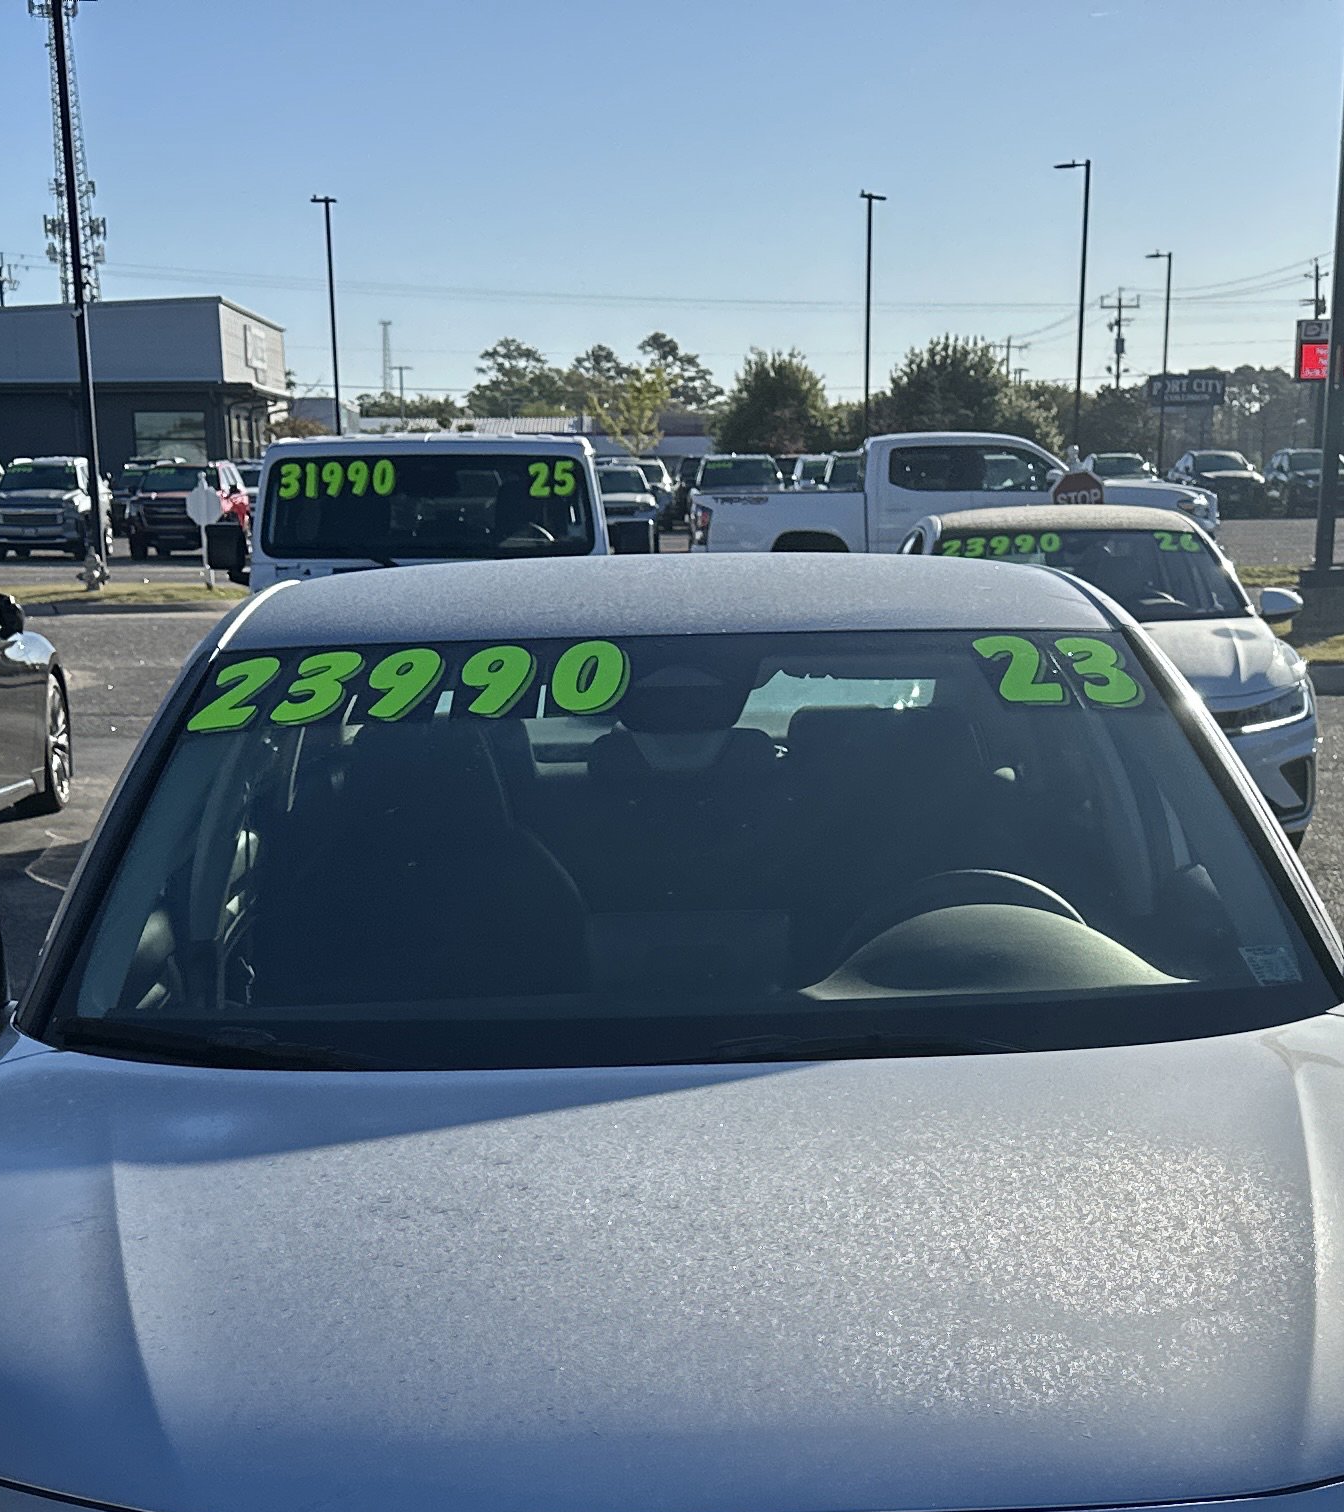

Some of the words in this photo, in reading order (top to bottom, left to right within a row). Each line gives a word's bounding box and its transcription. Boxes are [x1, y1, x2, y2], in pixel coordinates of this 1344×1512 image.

[278, 459, 396, 499] 31990
[528, 460, 576, 497] 25
[1056, 489, 1101, 504] STOP
[942, 533, 1061, 557] 23990
[1154, 533, 1200, 552] 26
[186, 640, 631, 733] 23990
[972, 635, 1145, 708] 23
